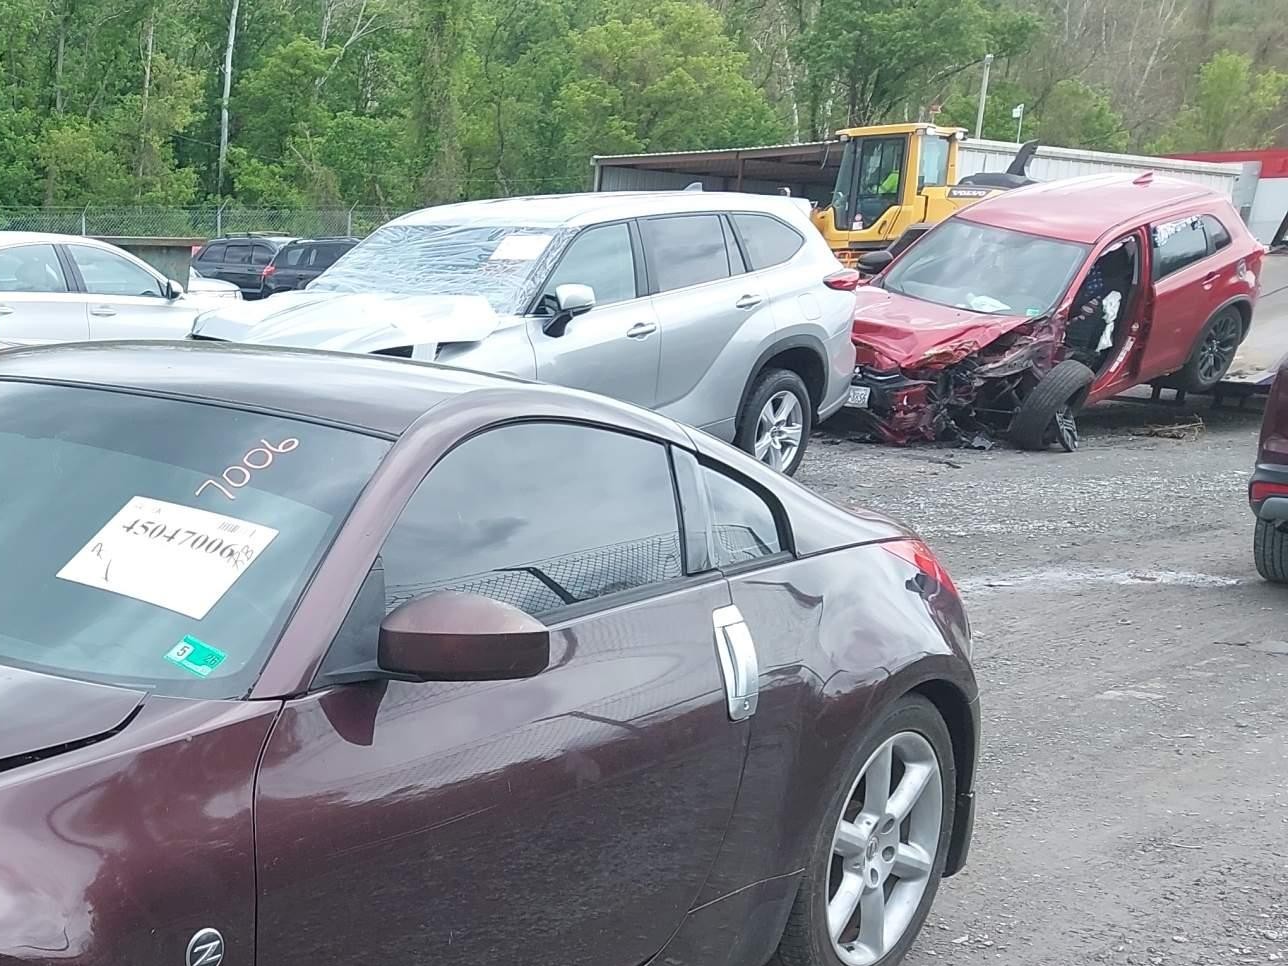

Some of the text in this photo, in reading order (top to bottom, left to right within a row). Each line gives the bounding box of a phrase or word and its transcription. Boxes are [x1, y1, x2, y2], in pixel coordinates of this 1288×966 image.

[951, 189, 987, 197] VOLVO
[195, 438, 299, 500] 7006
[121, 518, 238, 560] 45047006
[176, 645, 190, 657] 5
